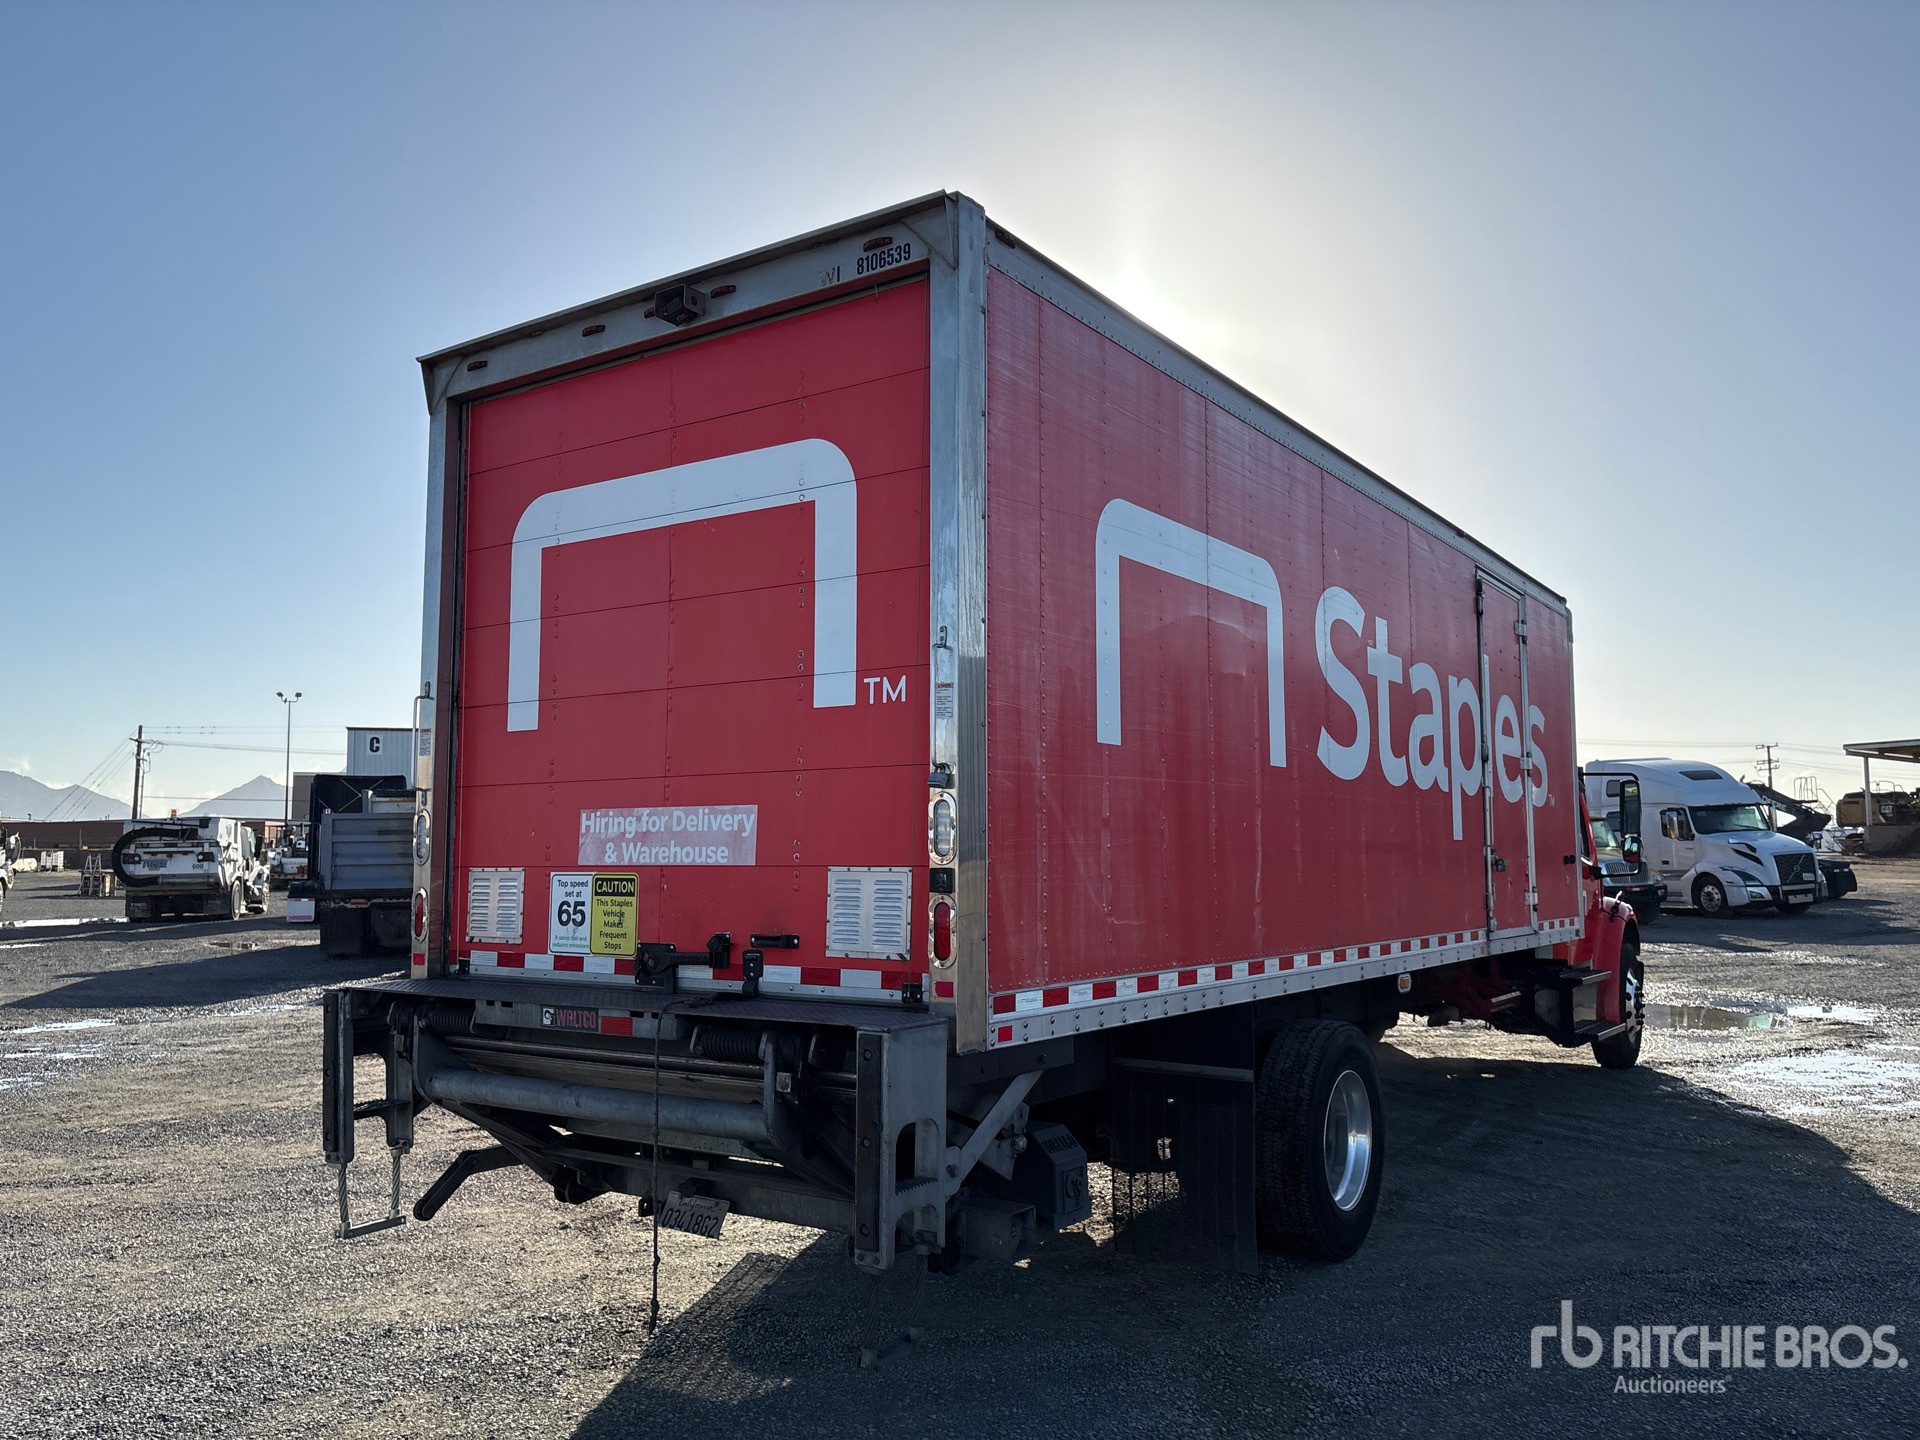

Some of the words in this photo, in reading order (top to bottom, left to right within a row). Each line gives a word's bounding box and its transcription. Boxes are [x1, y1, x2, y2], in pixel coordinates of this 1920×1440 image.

[856, 242, 912, 275] 8106539
[863, 674, 907, 705] TM
[1314, 586, 1549, 841] Staples
[369, 736, 380, 753] C
[1881, 805, 1893, 814] CAT
[581, 810, 637, 838] Hiring
[641, 809, 669, 833] for
[672, 808, 756, 837] Delivery
[604, 841, 617, 864] &
[621, 840, 729, 864] Warehouse
[557, 879, 569, 889] Top
[569, 878, 589, 889] speed
[595, 880, 635, 894] CAUTION
[564, 889, 574, 898] set
[574, 889, 583, 898] at
[596, 898, 609, 907] This
[609, 899, 633, 909] Staples
[557, 900, 587, 928] 65
[602, 909, 626, 918] Vehicle
[603, 919, 624, 929] Makes
[599, 930, 628, 941] Frequent
[603, 941, 622, 951] Stops
[556, 1008, 597, 1029] WALTCO
[678, 1198, 716, 1212] California
[661, 1207, 719, 1239] 03418G2
